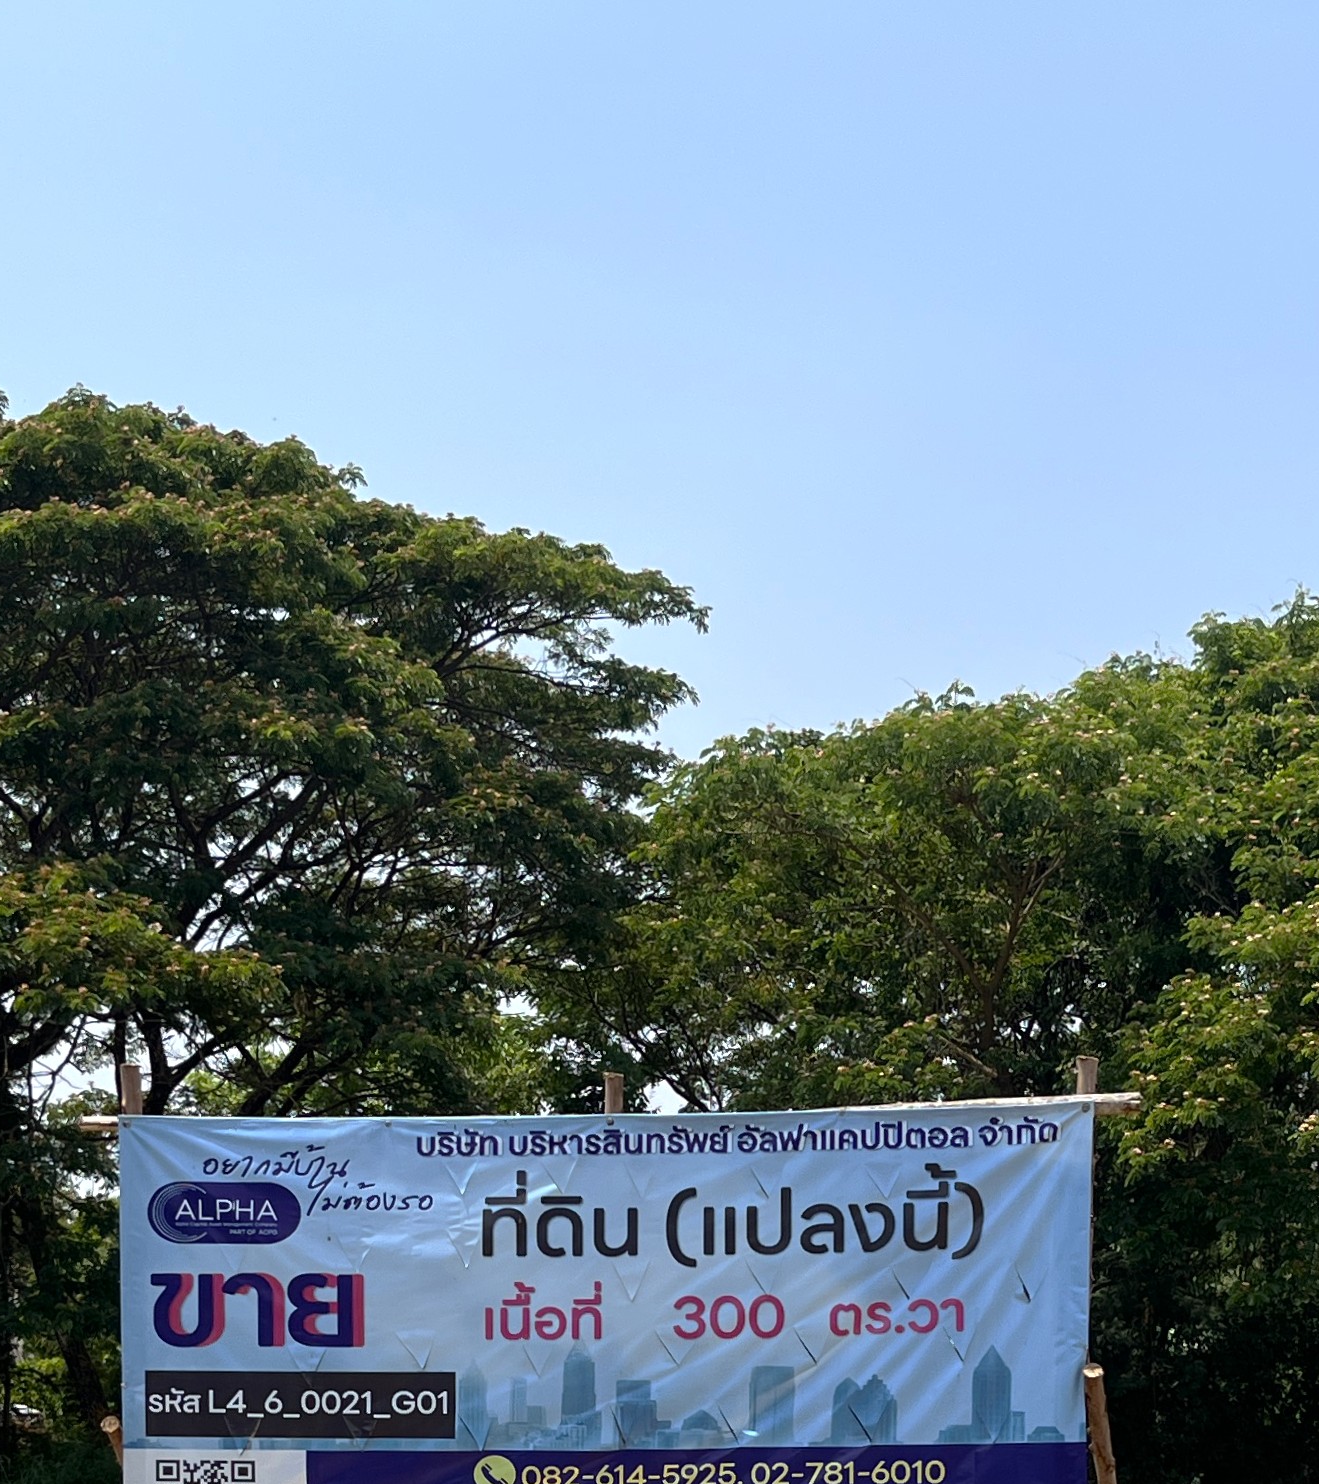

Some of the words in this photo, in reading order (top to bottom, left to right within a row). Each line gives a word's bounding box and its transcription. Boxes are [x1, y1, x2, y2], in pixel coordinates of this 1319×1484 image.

[416, 1128, 499, 1157] บริษัท
[509, 1124, 733, 1156] บริหารสินทรัพย์
[737, 1121, 972, 1153] อัลฟาแคปปิตอล
[978, 1116, 1061, 1147] จำกัด
[174, 1199, 279, 1222] ALPHA
[481, 1169, 639, 1258] ที่ดิน
[666, 1162, 985, 1268] (แปลงนี้)
[150, 1272, 365, 1348] ขาย
[484, 1281, 603, 1341] เนื้อที่
[673, 1295, 786, 1340] 300
[828, 1298, 966, 1338] ตร.วา
[148, 1388, 201, 1414] รหัส
[208, 1389, 449, 1419] L4_6_0021_G01
